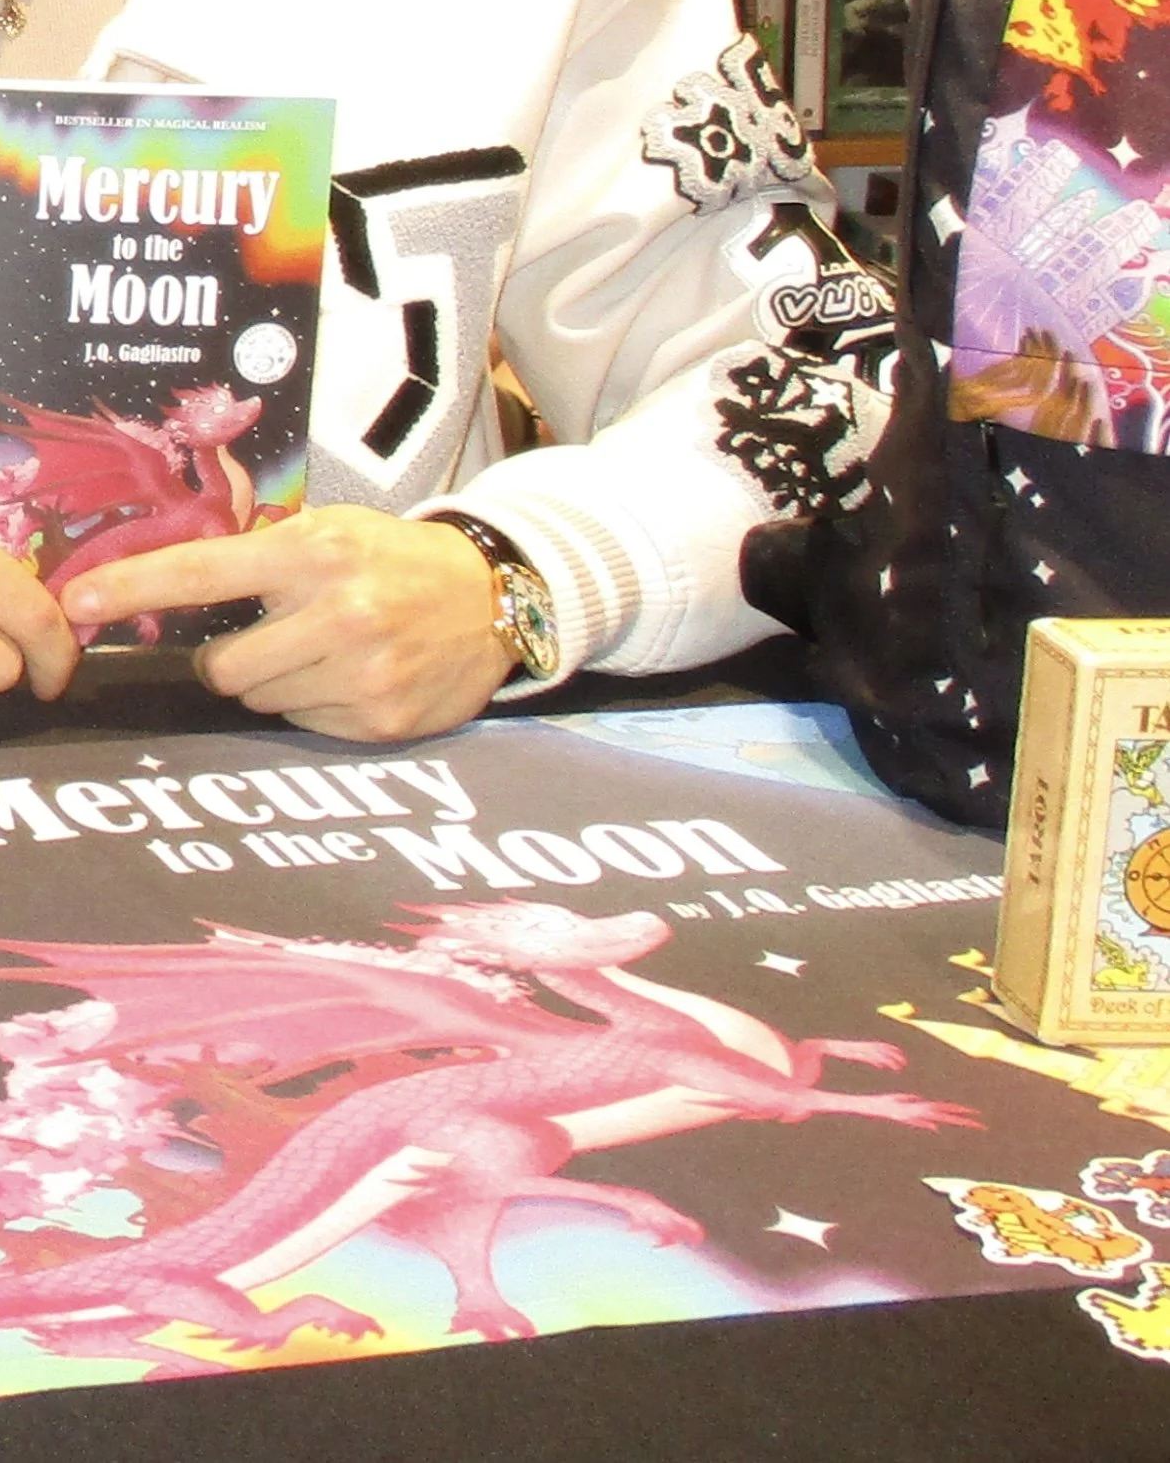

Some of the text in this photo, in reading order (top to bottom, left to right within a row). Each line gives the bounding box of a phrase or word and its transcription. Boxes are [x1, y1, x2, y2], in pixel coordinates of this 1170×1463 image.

[54, 114, 267, 131] BESTSELLER IN MAGICAL REALISM
[34, 154, 280, 236] Mercury
[112, 233, 185, 262] to the
[67, 263, 220, 327] Moon
[83, 341, 203, 365] J.Q. Gagliastro
[145, 818, 788, 891] to the Moon
[666, 897, 712, 921] by
[702, 888, 808, 920] J.Q.
